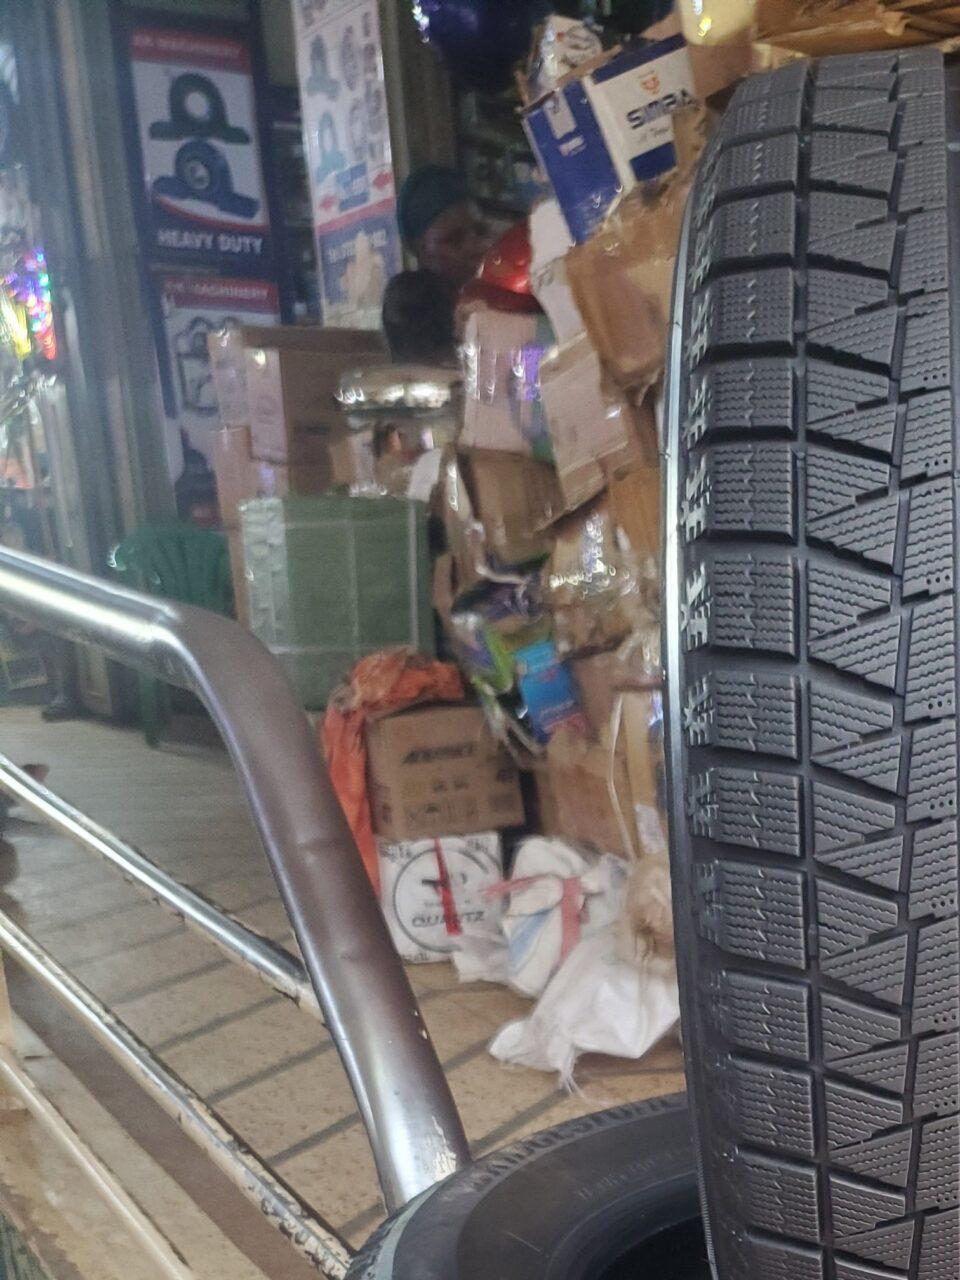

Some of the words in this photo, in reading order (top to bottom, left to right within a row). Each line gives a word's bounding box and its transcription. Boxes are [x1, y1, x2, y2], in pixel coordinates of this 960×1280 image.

[158, 228, 214, 249] HEAVY
[216, 233, 263, 254] DUTY
[411, 911, 485, 928] QUTZ
